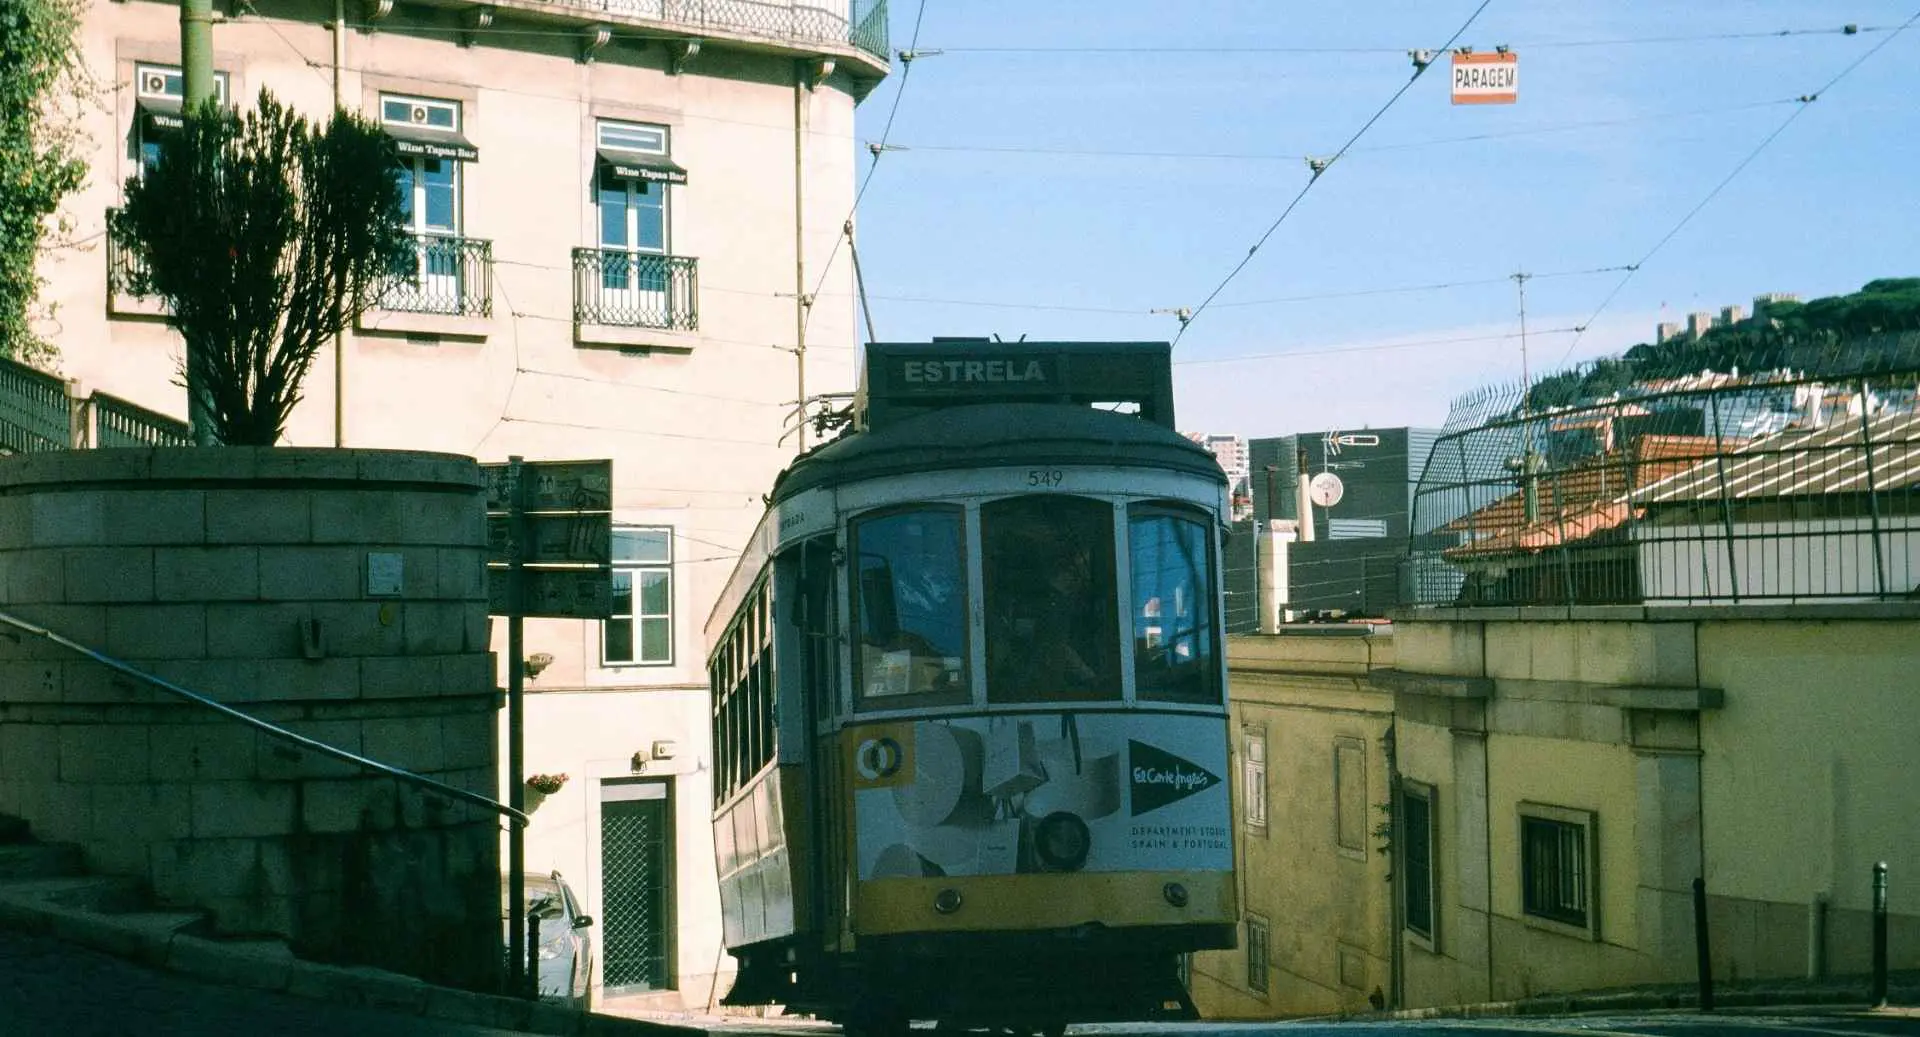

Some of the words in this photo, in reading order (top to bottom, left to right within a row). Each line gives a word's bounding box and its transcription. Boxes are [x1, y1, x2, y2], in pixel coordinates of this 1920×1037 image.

[1455, 68, 1515, 88] PARAGEM
[397, 141, 424, 154] Wine
[425, 144, 457, 157] Tapas
[457, 148, 477, 158] Bar
[615, 166, 640, 177] Wine
[640, 168, 668, 181] Tapas
[668, 171, 687, 181] Bar
[904, 360, 1046, 383] ESTRELA
[1028, 470, 1064, 488] 549
[1133, 766, 1146, 784] El
[1146, 766, 1175, 785] Corte
[1131, 827, 1196, 836] DEPARTMENT
[1130, 840, 1166, 849] SPAIN
[1184, 840, 1228, 850] PORTUGAL
